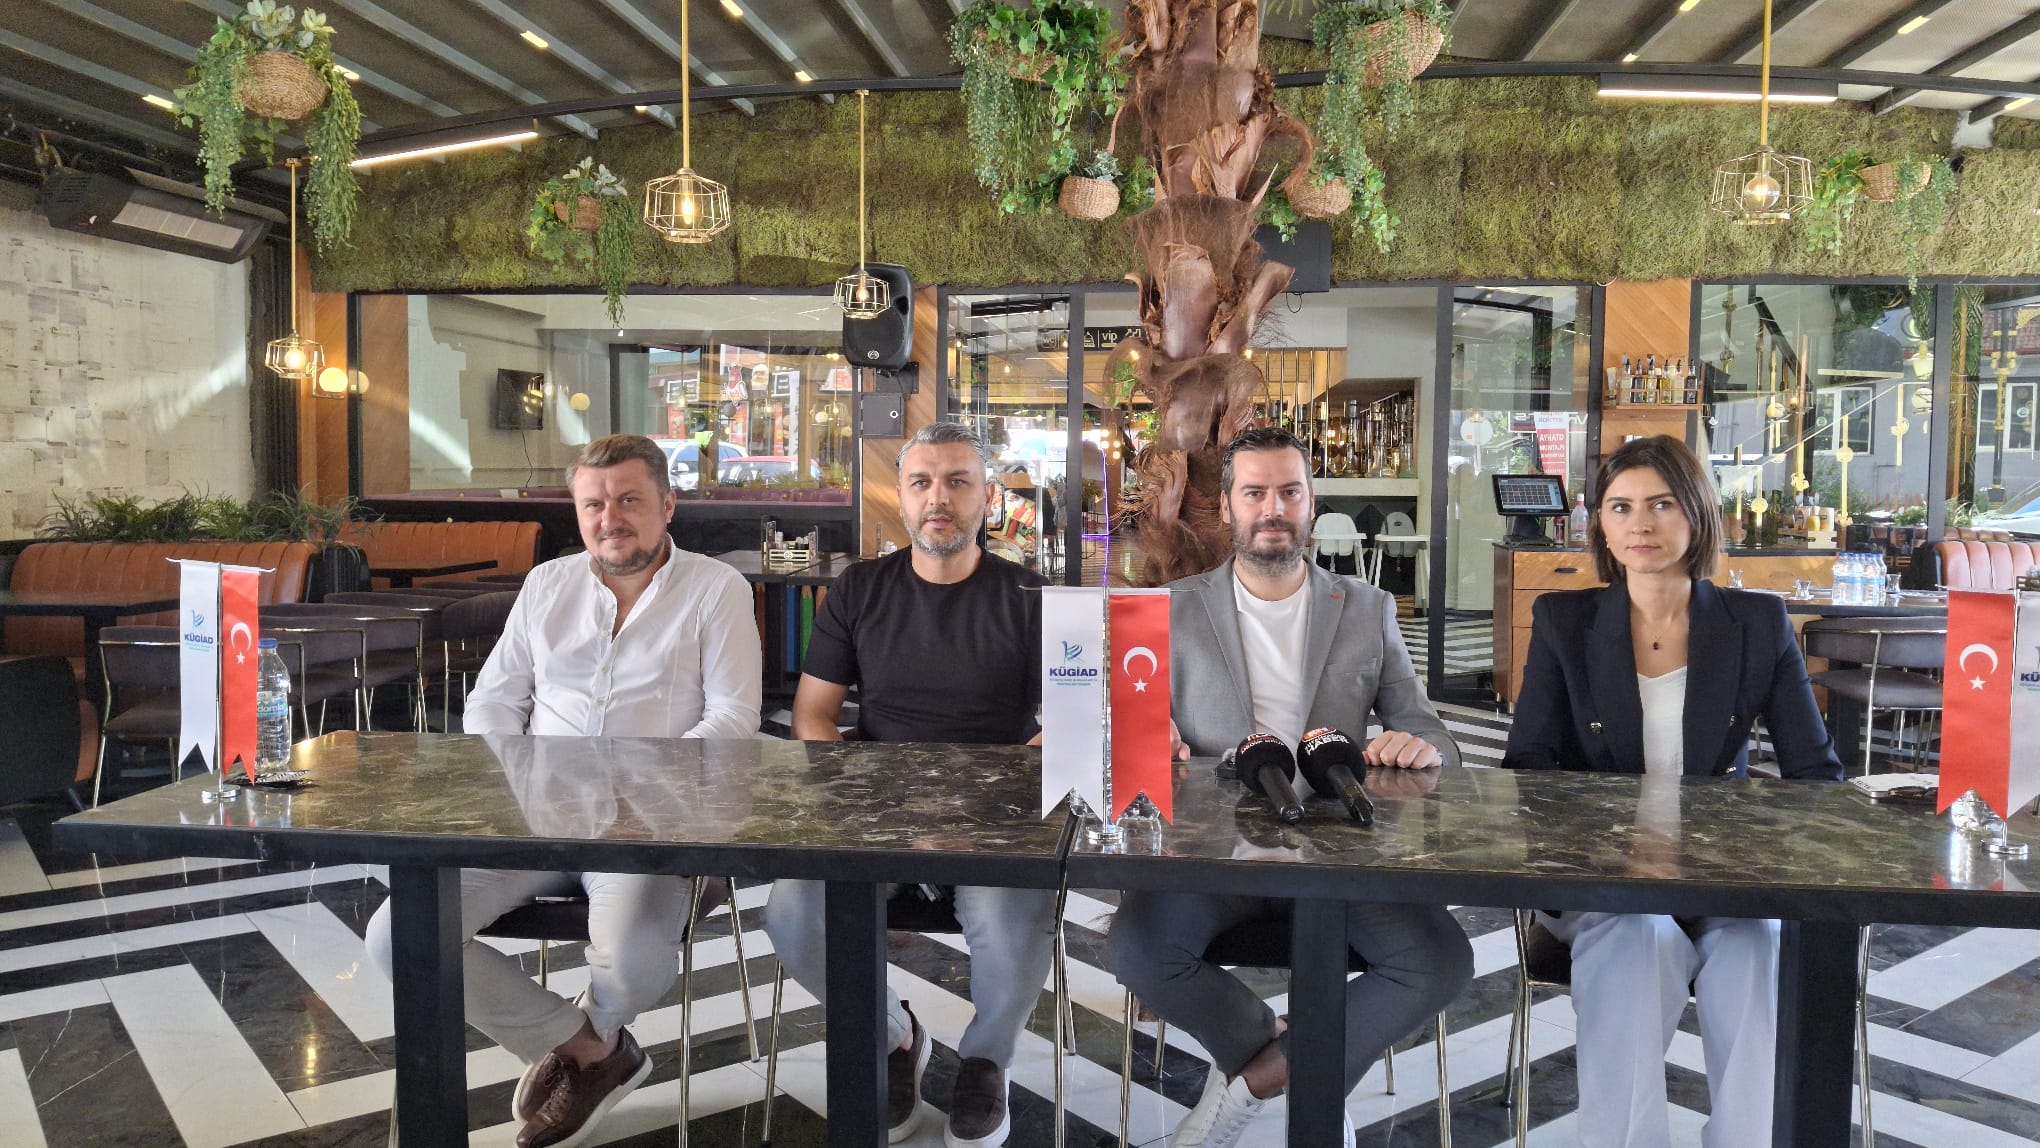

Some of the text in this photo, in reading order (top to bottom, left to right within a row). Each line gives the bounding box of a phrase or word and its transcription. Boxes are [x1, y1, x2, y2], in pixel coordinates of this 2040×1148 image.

[1102, 331, 1117, 343] vip
[184, 632, 214, 644] KÜGİAD
[1049, 666, 1098, 677] KÜGİAD
